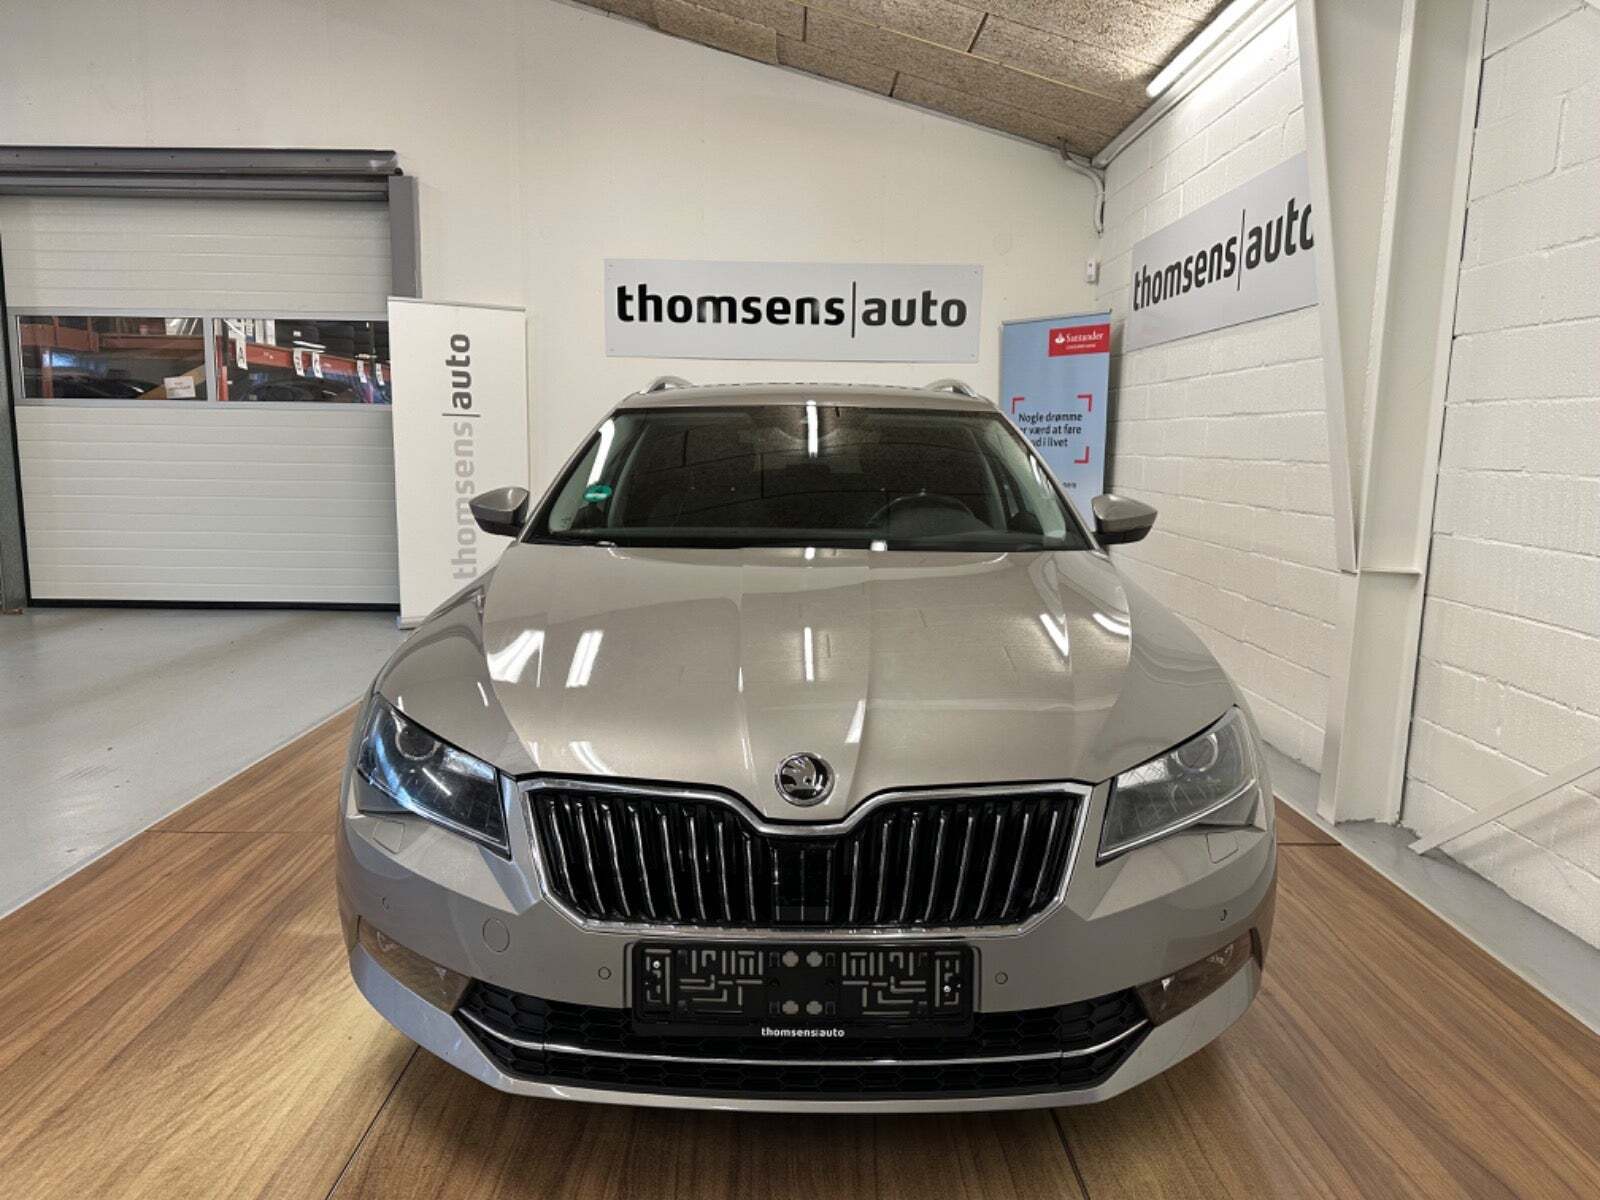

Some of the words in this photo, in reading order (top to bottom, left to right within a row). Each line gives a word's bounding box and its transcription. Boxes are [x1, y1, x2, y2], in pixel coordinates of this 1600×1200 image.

[1133, 235, 1237, 311] thomsens
[616, 283, 845, 326] thomsens
[861, 290, 967, 327] auto
[1066, 330, 1104, 344] Santander
[445, 333, 472, 410] auto
[1019, 412, 1043, 425] Nogle
[1046, 411, 1082, 422] drømme
[1052, 425, 1062, 434] at
[1047, 436, 1068, 447] livet
[451, 422, 477, 580] thomsens
[761, 1026, 817, 1037] thomsens
[819, 1027, 845, 1037] auto
